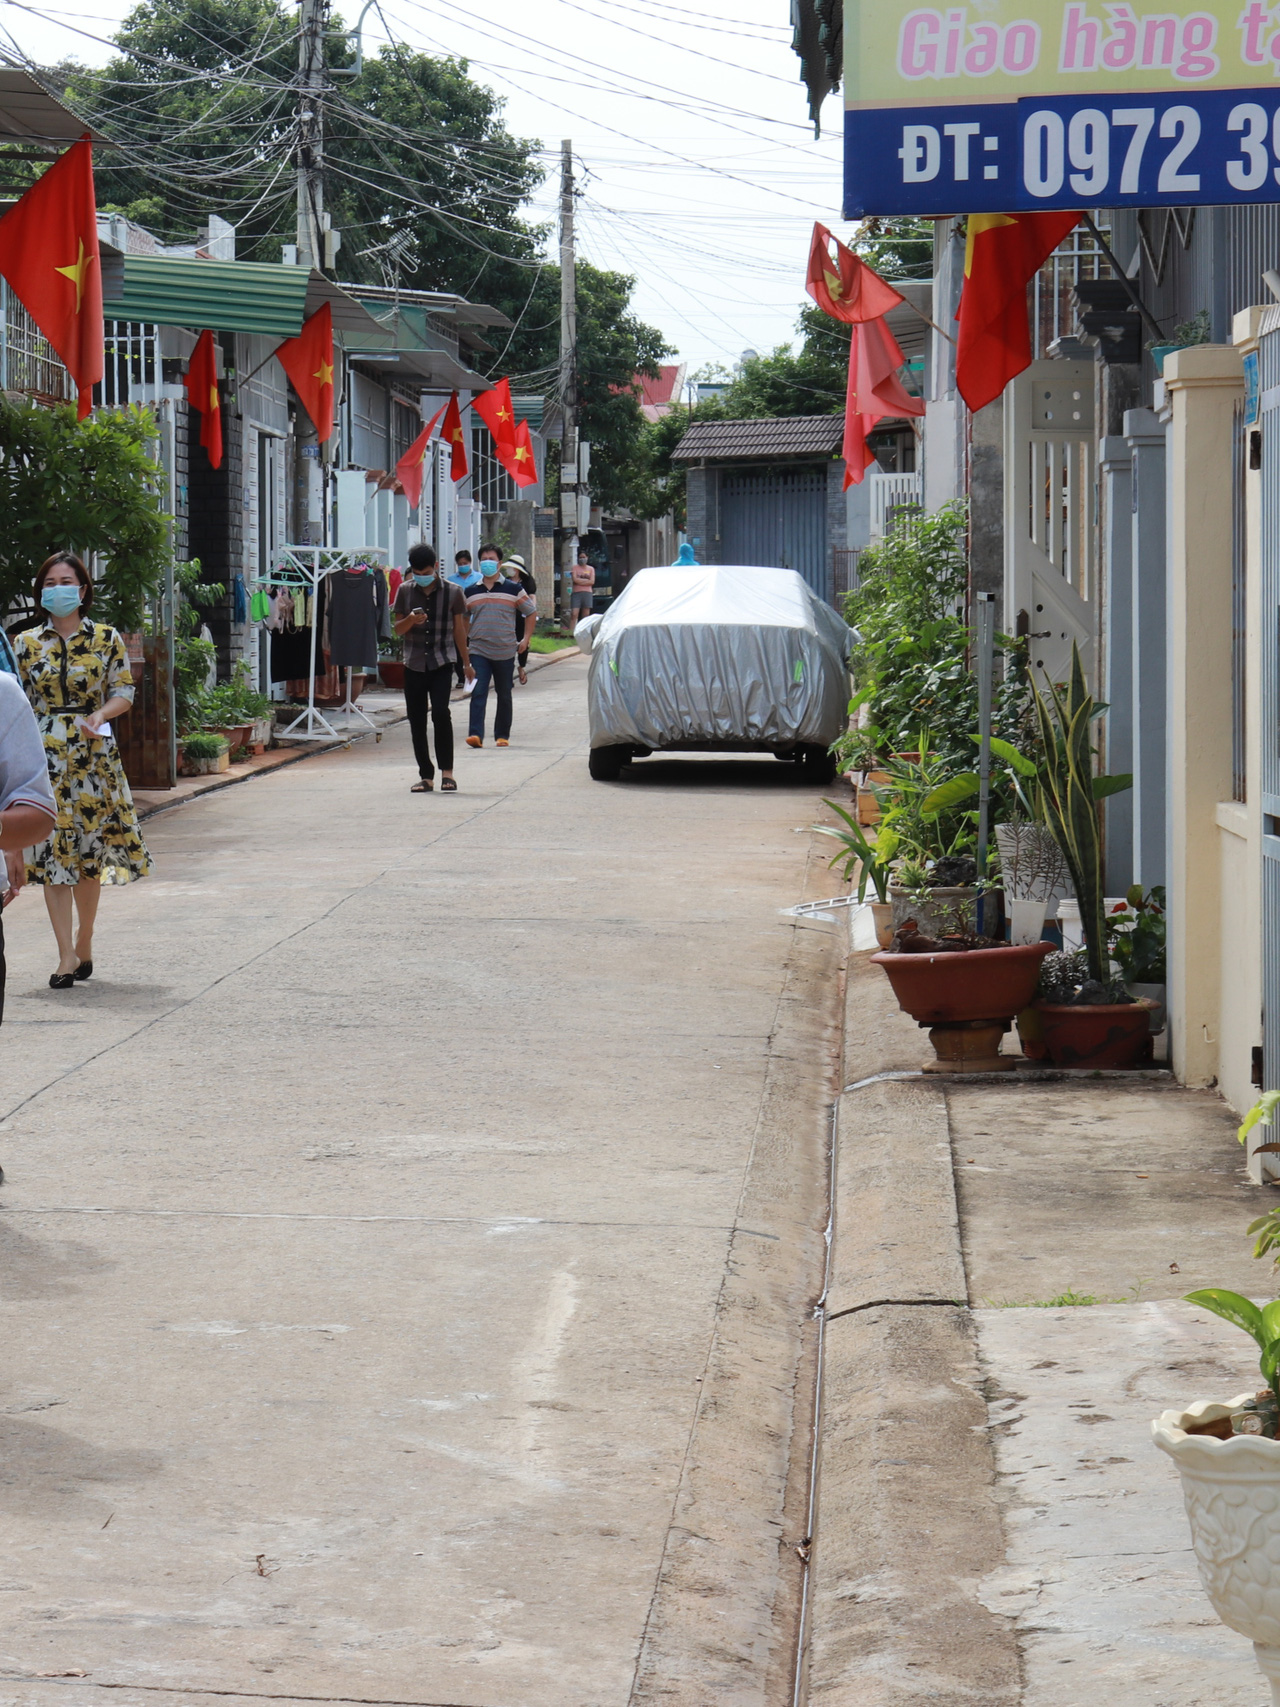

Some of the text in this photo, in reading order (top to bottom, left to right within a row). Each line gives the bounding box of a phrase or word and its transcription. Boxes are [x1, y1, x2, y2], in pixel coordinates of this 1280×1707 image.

[900, 2, 1280, 78] Giao hàng t
[898, 103, 1280, 198] ĐT: 0972 3
